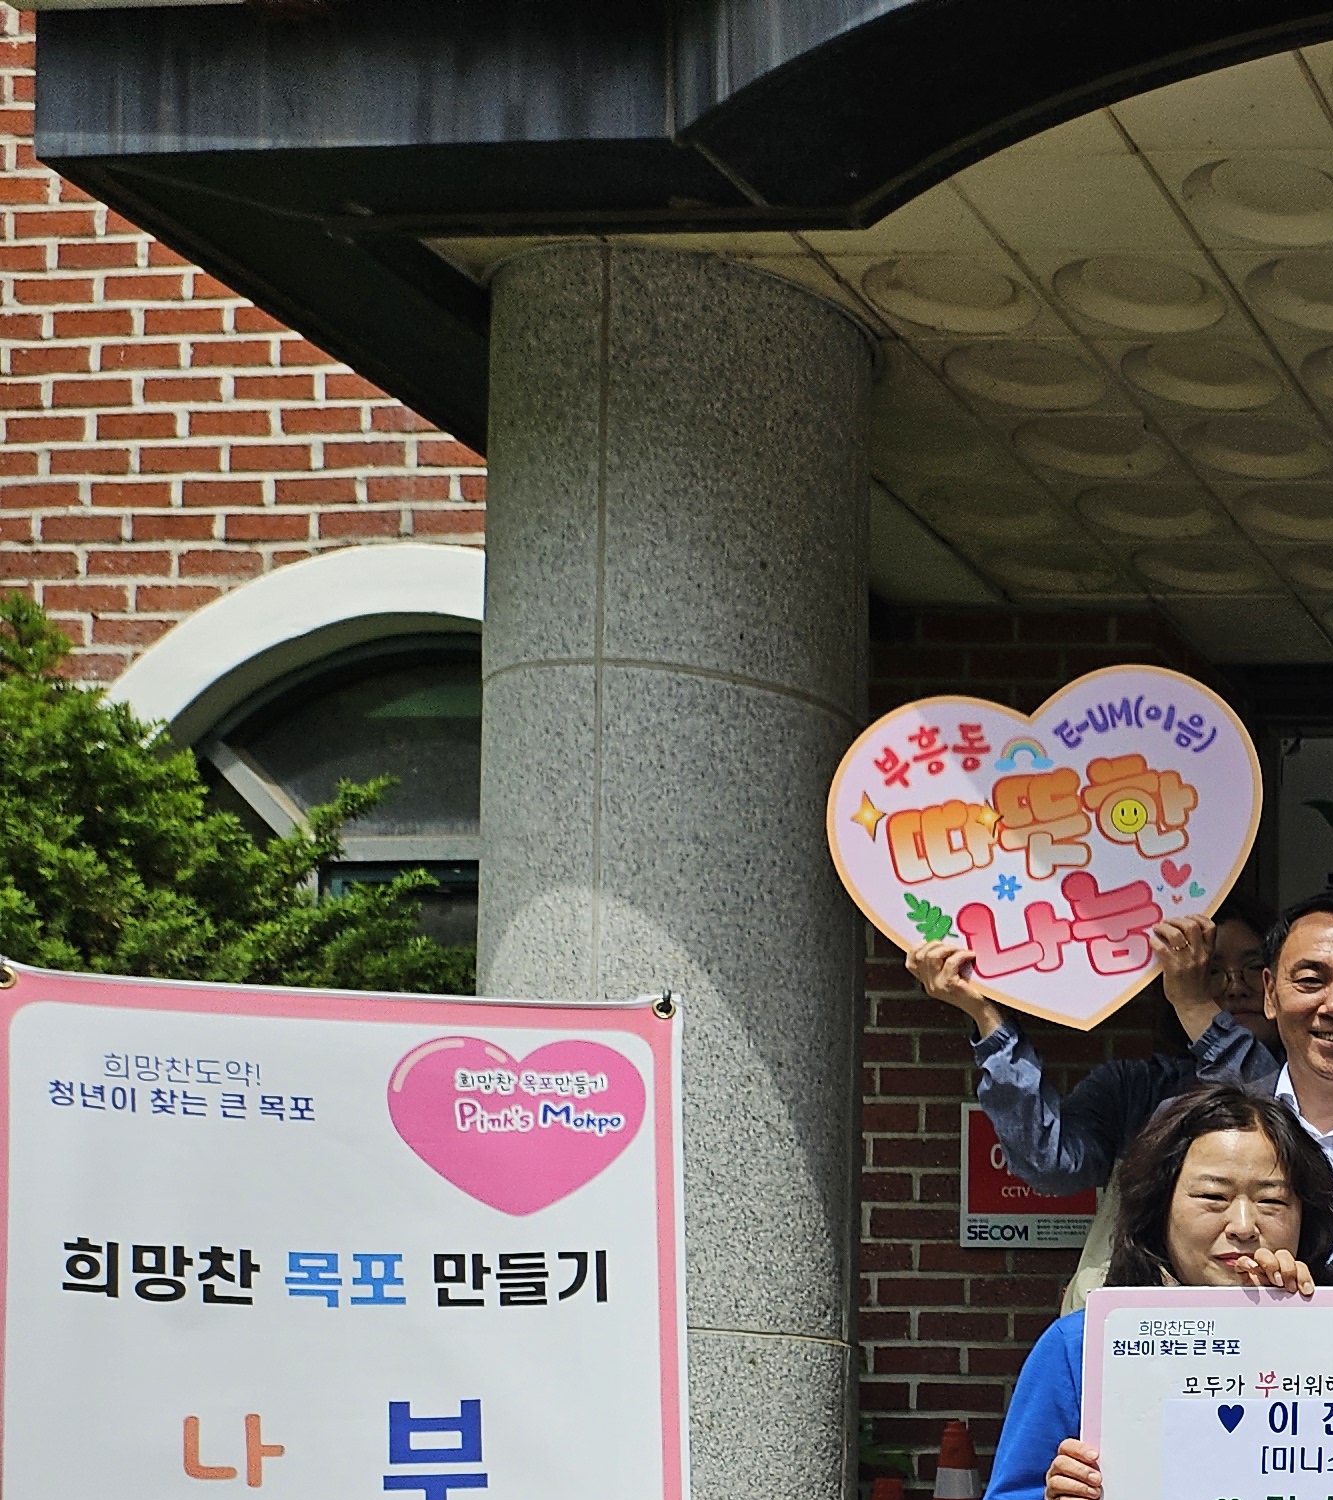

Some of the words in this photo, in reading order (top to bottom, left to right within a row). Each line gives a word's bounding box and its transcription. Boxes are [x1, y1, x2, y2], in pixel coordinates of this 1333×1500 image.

[874, 724, 990, 789] 부흥동
[1054, 695, 1217, 754] E-UM(이음)
[886, 754, 1198, 885] 따뜻한
[957, 871, 1163, 980] 나눔
[103, 1051, 262, 1085] 희망찬도약!
[458, 1070, 516, 1092] 희망찬
[47, 1079, 139, 1114] 청년이
[149, 1089, 207, 1118] 찾는
[219, 1093, 248, 1119] 큰
[258, 1094, 316, 1122] 목포
[1002, 1186, 1030, 1197] CCTV
[967, 1225, 1028, 1241] SECOM
[62, 1236, 261, 1306] 희망찬
[284, 1251, 407, 1308] 목포
[432, 1249, 609, 1307] 만들기
[1138, 1319, 1215, 1337] 희망찬도약!
[1112, 1339, 1155, 1358] 청년이
[1159, 1339, 1188, 1358] 찾는
[1192, 1339, 1206, 1358] 큰
[1211, 1338, 1241, 1357] 목포
[1183, 1374, 1245, 1397] 모두가
[1267, 1401, 1299, 1436] 이
